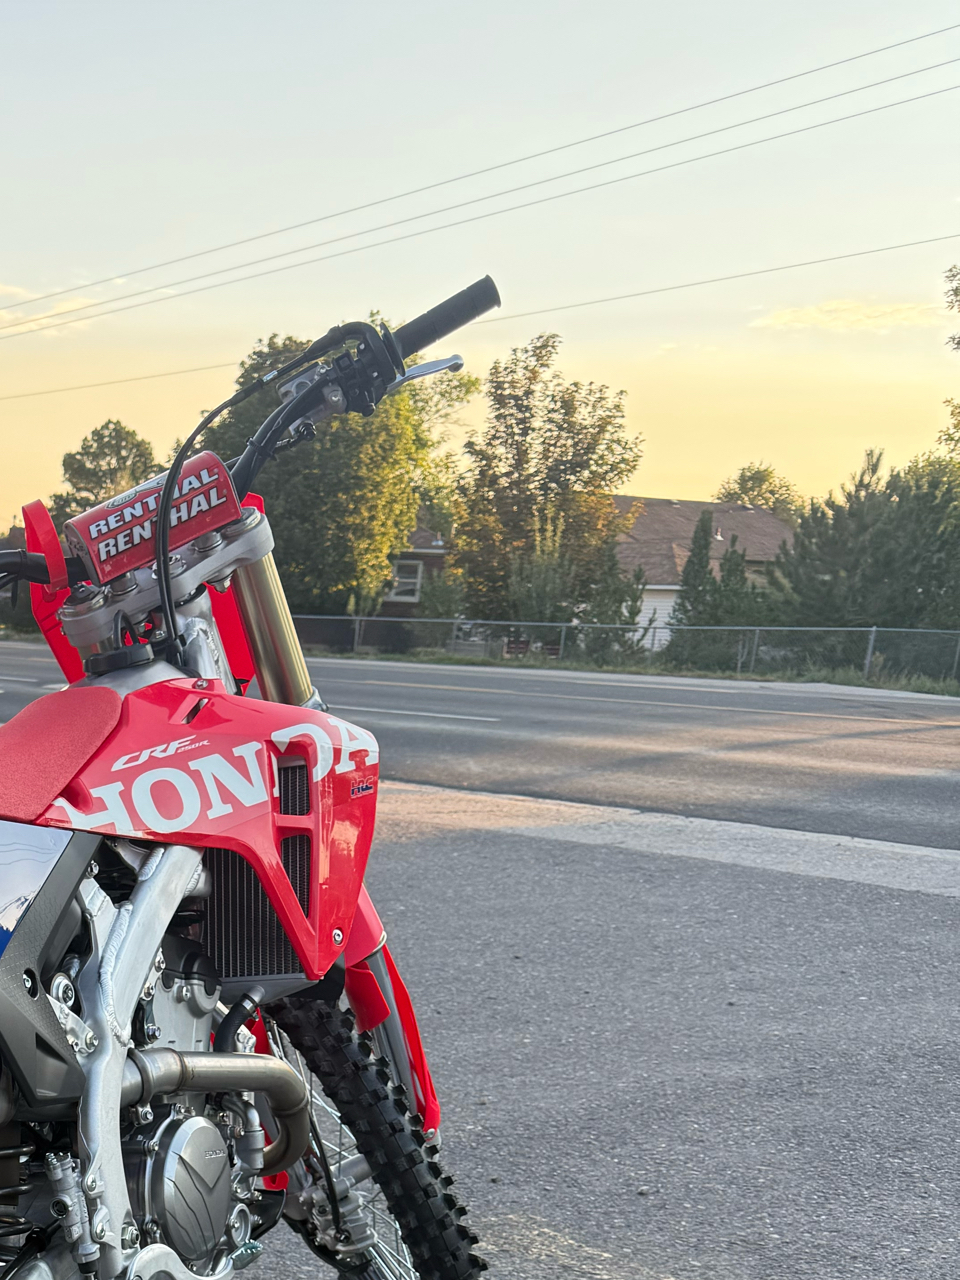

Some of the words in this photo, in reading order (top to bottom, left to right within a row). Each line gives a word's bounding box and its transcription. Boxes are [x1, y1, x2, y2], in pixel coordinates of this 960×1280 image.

[89, 468, 219, 540] RENTAL
[98, 487, 227, 562] RENHAL
[110, 734, 197, 772] CRF
[177, 739, 211, 753] 250R
